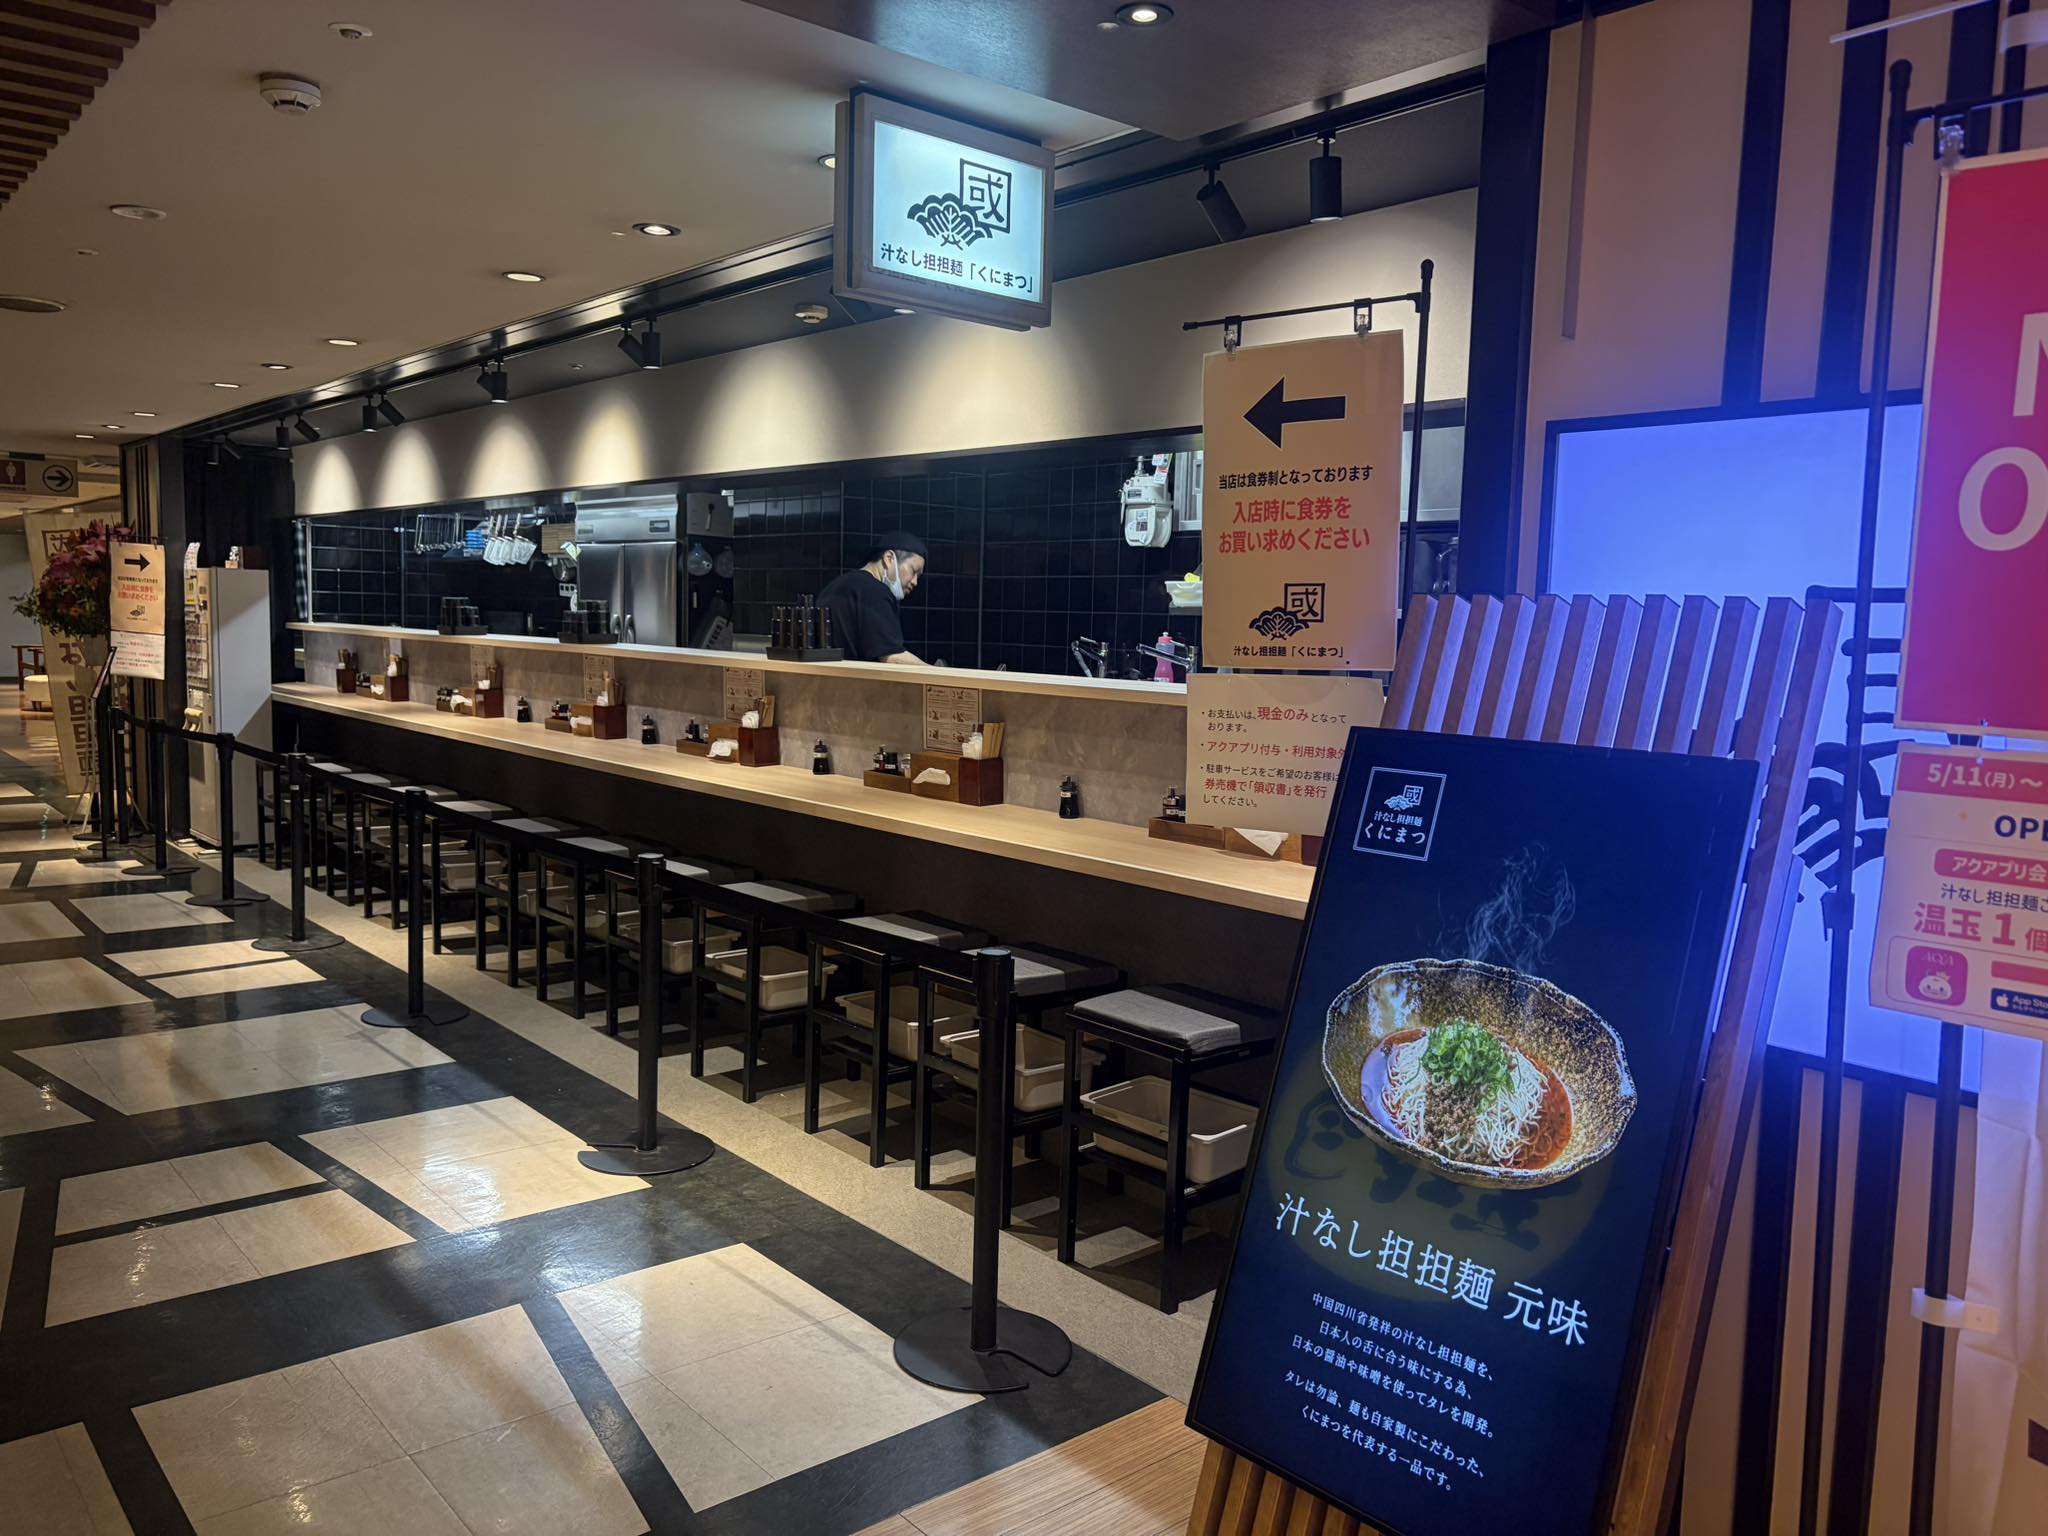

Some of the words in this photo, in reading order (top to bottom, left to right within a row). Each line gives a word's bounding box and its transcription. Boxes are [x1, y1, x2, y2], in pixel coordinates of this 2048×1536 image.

[1218, 465, 1374, 490] 当店は食券制となっております
[1232, 496, 1353, 525] 入店時に食券を
[1218, 527, 1371, 555] お買い求めください
[1206, 721, 1248, 734] おります。
[1373, 811, 1424, 827] 汁なし担担麺
[1364, 822, 1427, 845] くにまつ
[1952, 856, 2047, 883] アクアプリ会
[1275, 1192, 1497, 1312] 汁なし担担麺
[1502, 1280, 1590, 1347] 元味
[1312, 1292, 1494, 1382] 中国四川省発祥の汁なし担担麺を、
[1318, 1320, 1472, 1401] 日本人の舌に合う味にする為、
[1300, 1404, 1452, 1492] くにまつを代表する一品です。
